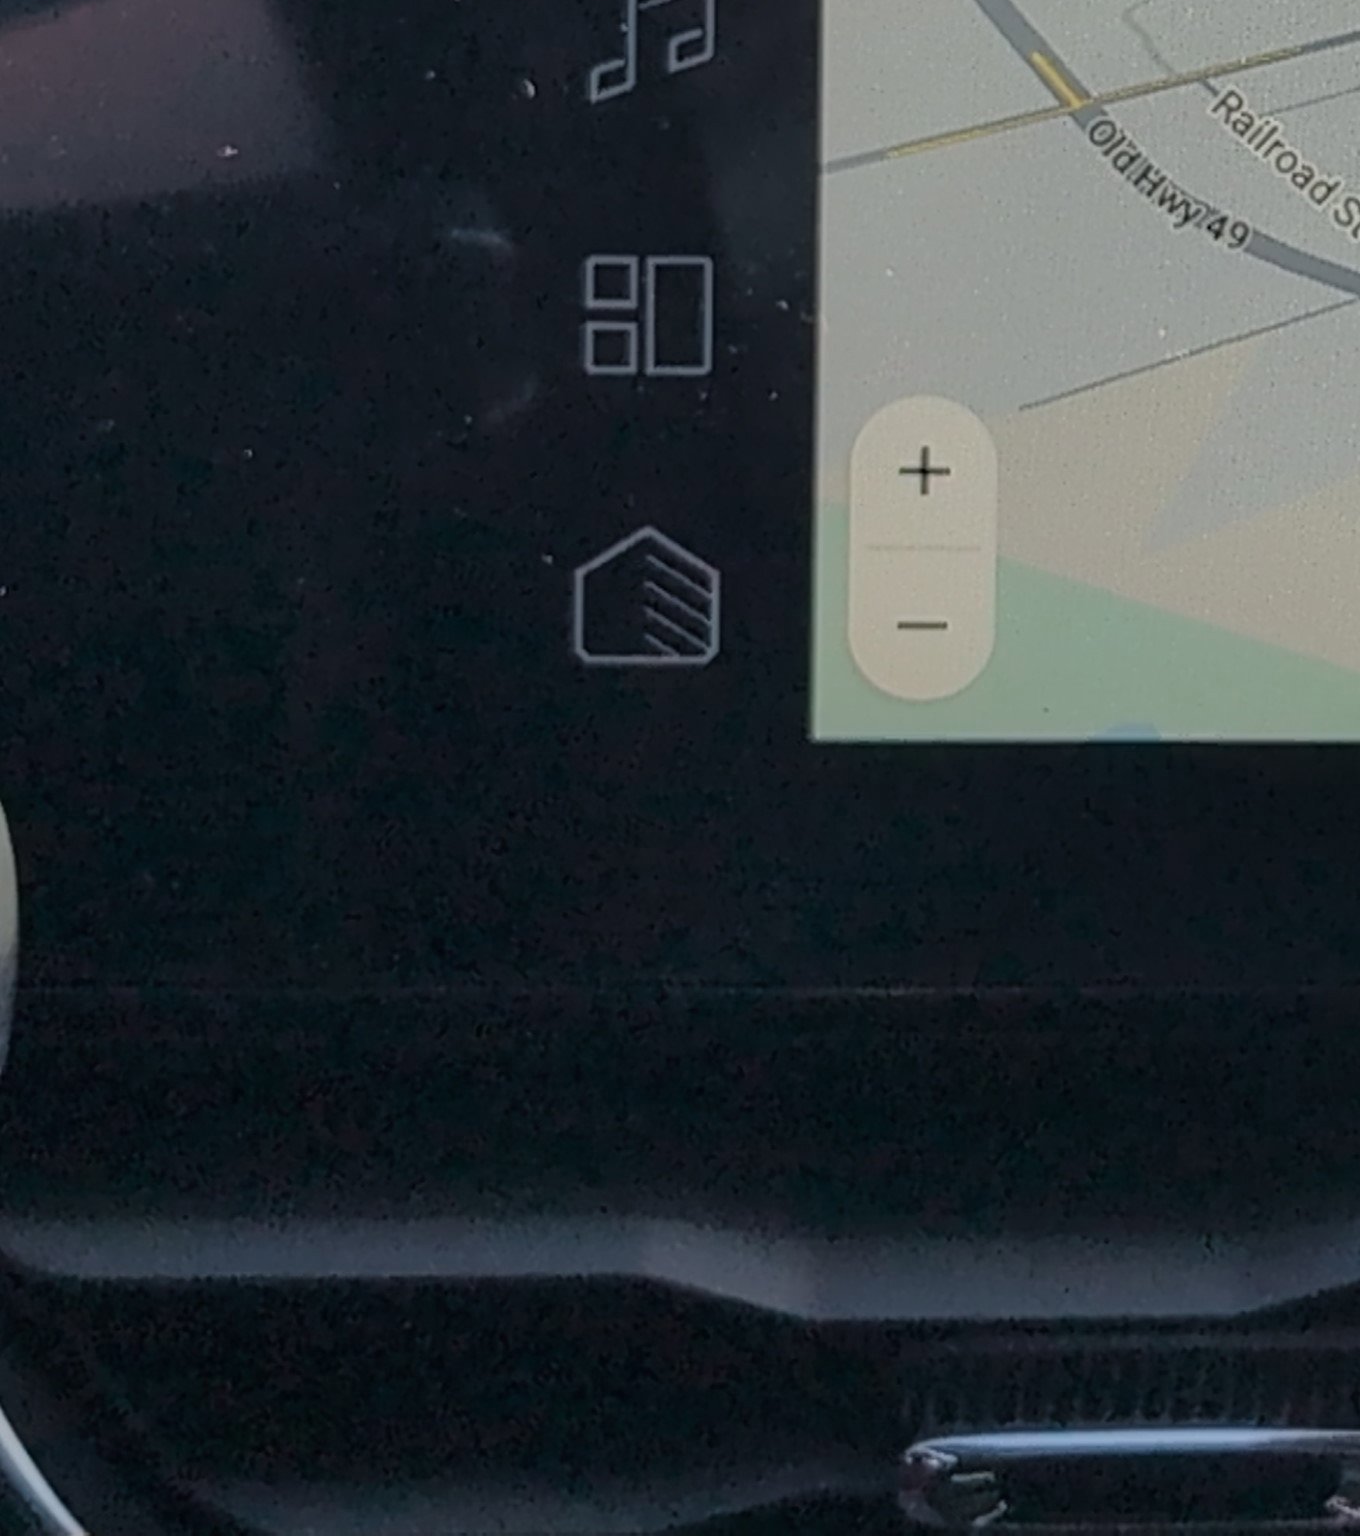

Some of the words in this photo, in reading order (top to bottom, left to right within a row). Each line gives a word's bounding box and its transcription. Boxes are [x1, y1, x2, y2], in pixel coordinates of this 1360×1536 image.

[1087, 117, 1142, 176] Old
[1130, 161, 1203, 230] Hwy
[1204, 212, 1251, 251] 49
[1210, 88, 1344, 208] Railroad
